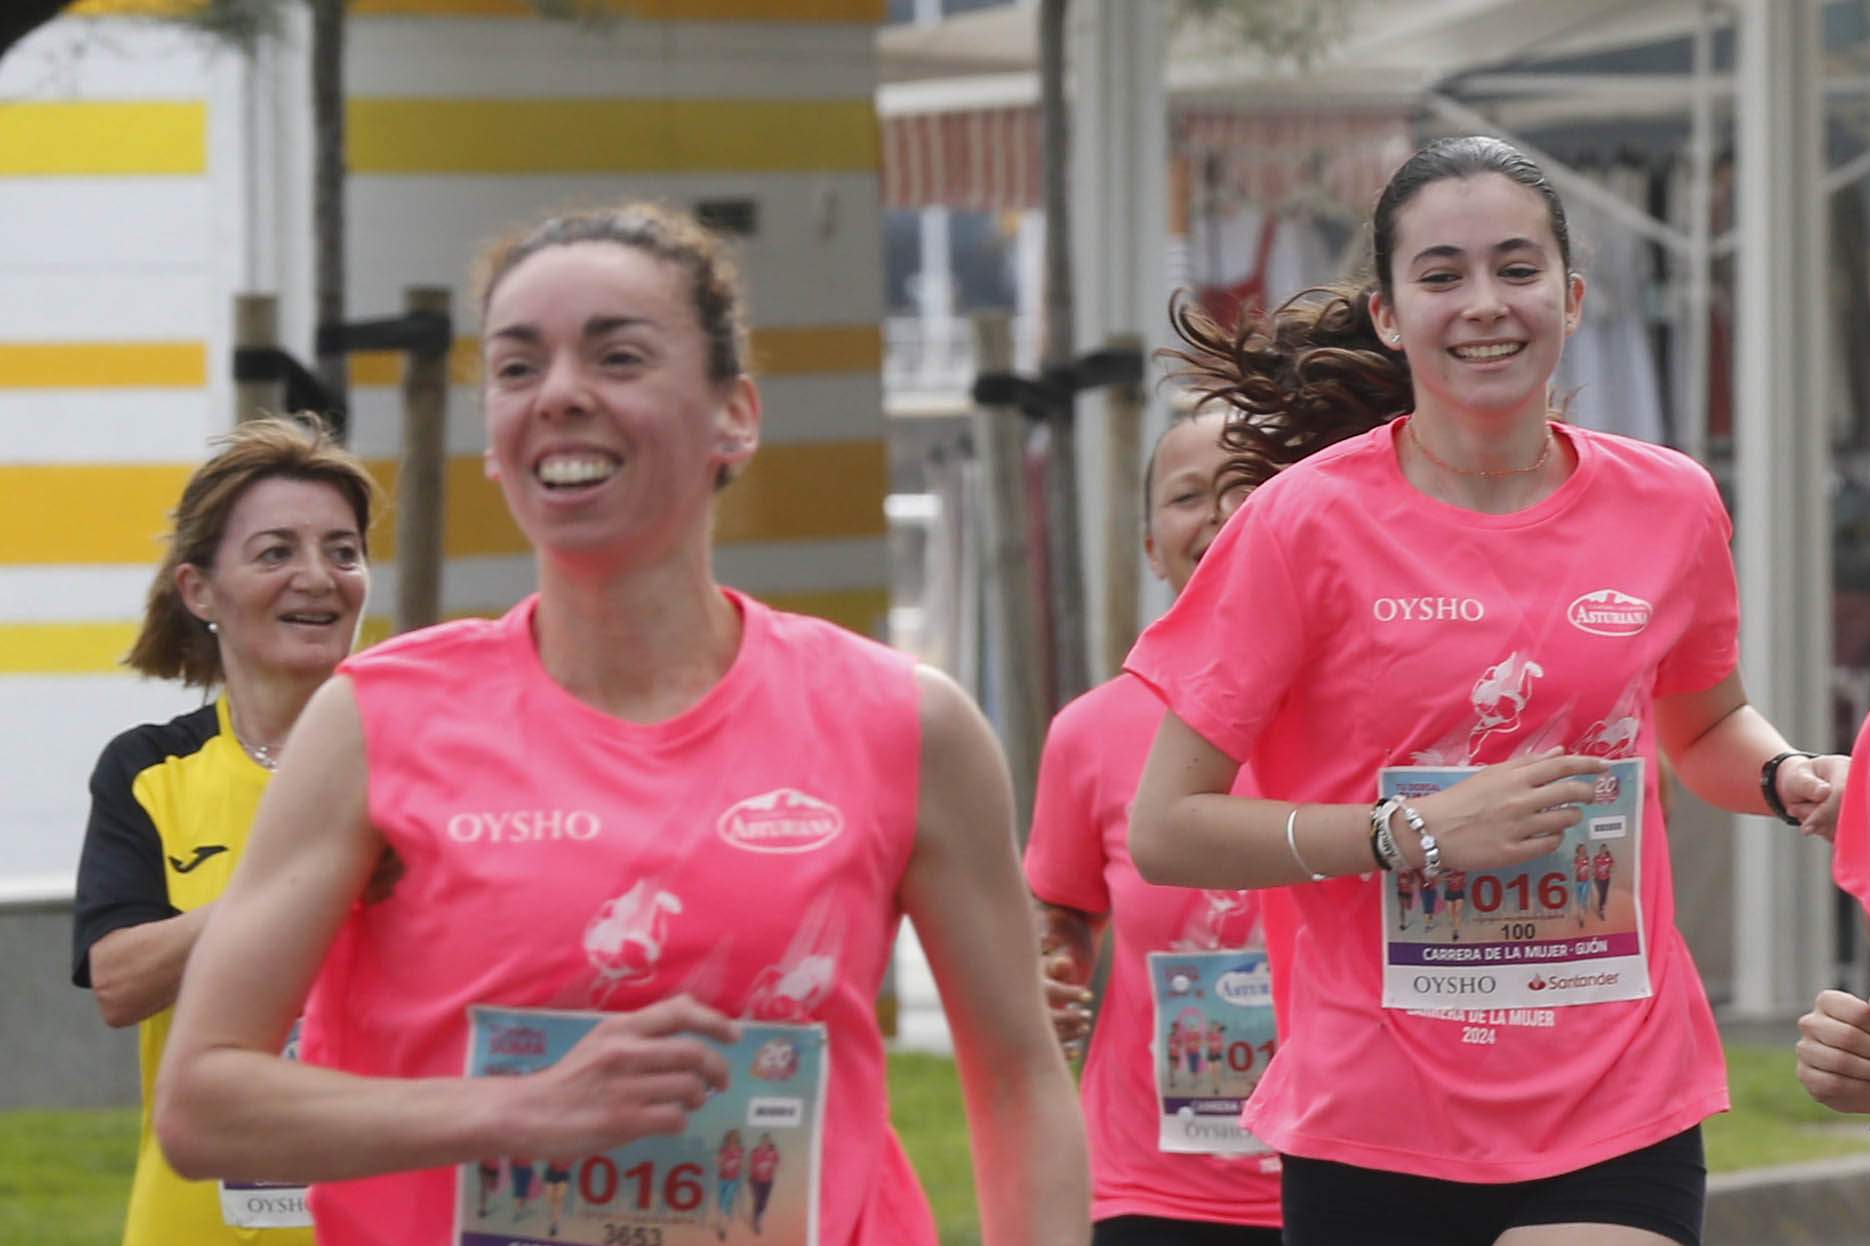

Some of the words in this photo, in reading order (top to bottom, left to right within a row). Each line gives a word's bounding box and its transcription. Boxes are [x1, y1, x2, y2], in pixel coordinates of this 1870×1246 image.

[1374, 597, 1484, 622] OYSHO
[1576, 605, 1647, 626] ASTURIANA
[447, 809, 600, 844] OYSHO
[1471, 872, 1569, 912] 016
[1501, 923, 1536, 940] 100
[1423, 946, 1482, 962] CARRERA
[1484, 944, 1501, 960] DE
[1504, 944, 1521, 960] LA
[1524, 942, 1569, 959] MUJER
[1413, 975, 1496, 994] OYSHO
[1548, 971, 1620, 991] Santander
[1489, 1010, 1507, 1025] LA
[1508, 1010, 1555, 1027] MUJER
[1462, 1026, 1496, 1045] 2024
[578, 1155, 705, 1213] 016
[247, 1197, 306, 1214] OYSH
